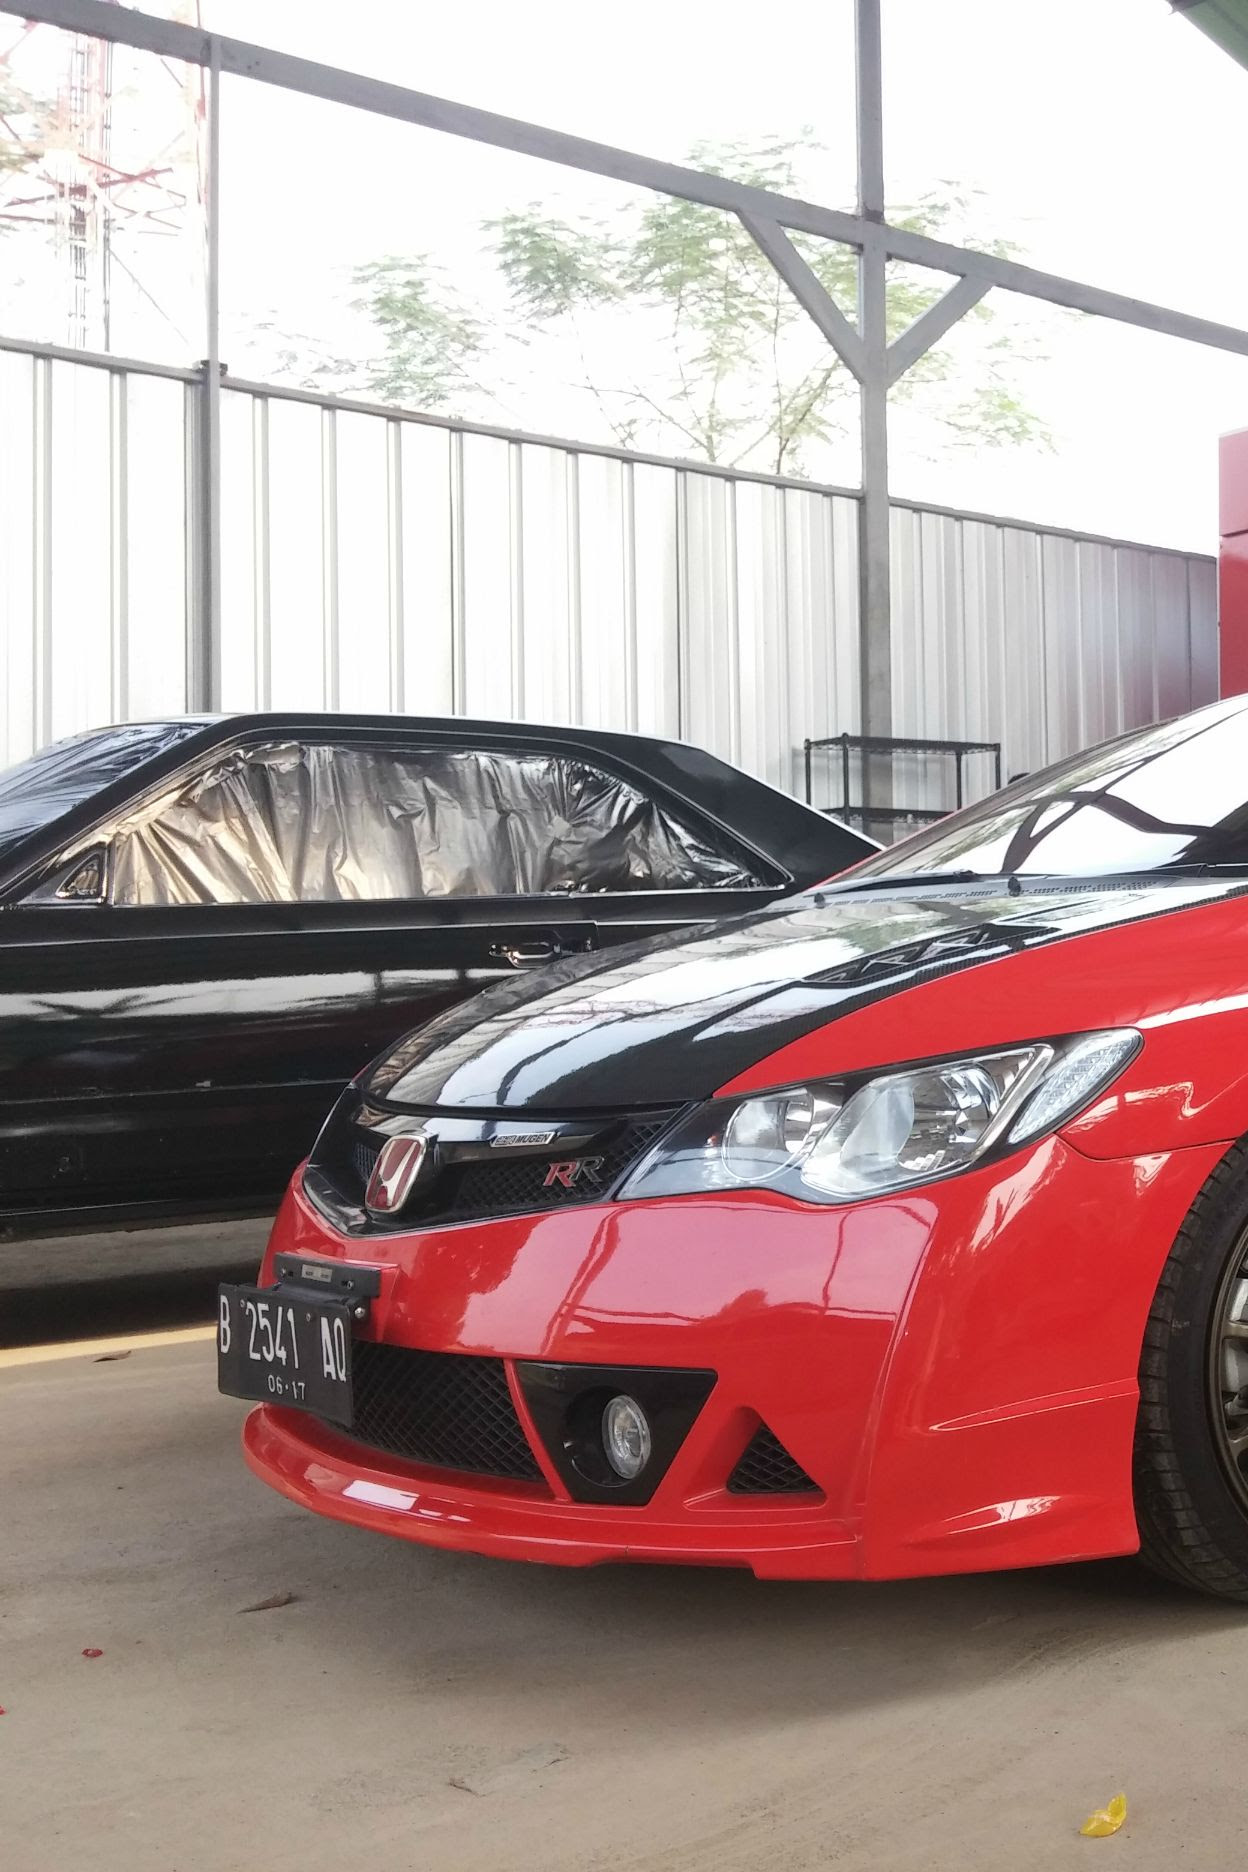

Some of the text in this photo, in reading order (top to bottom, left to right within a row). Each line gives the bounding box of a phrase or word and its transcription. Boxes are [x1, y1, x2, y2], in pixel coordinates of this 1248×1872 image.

[515, 1133, 552, 1144] MUGEN
[543, 1155, 605, 1188] RR
[220, 1294, 231, 1353] B
[245, 1302, 299, 1369] 2541
